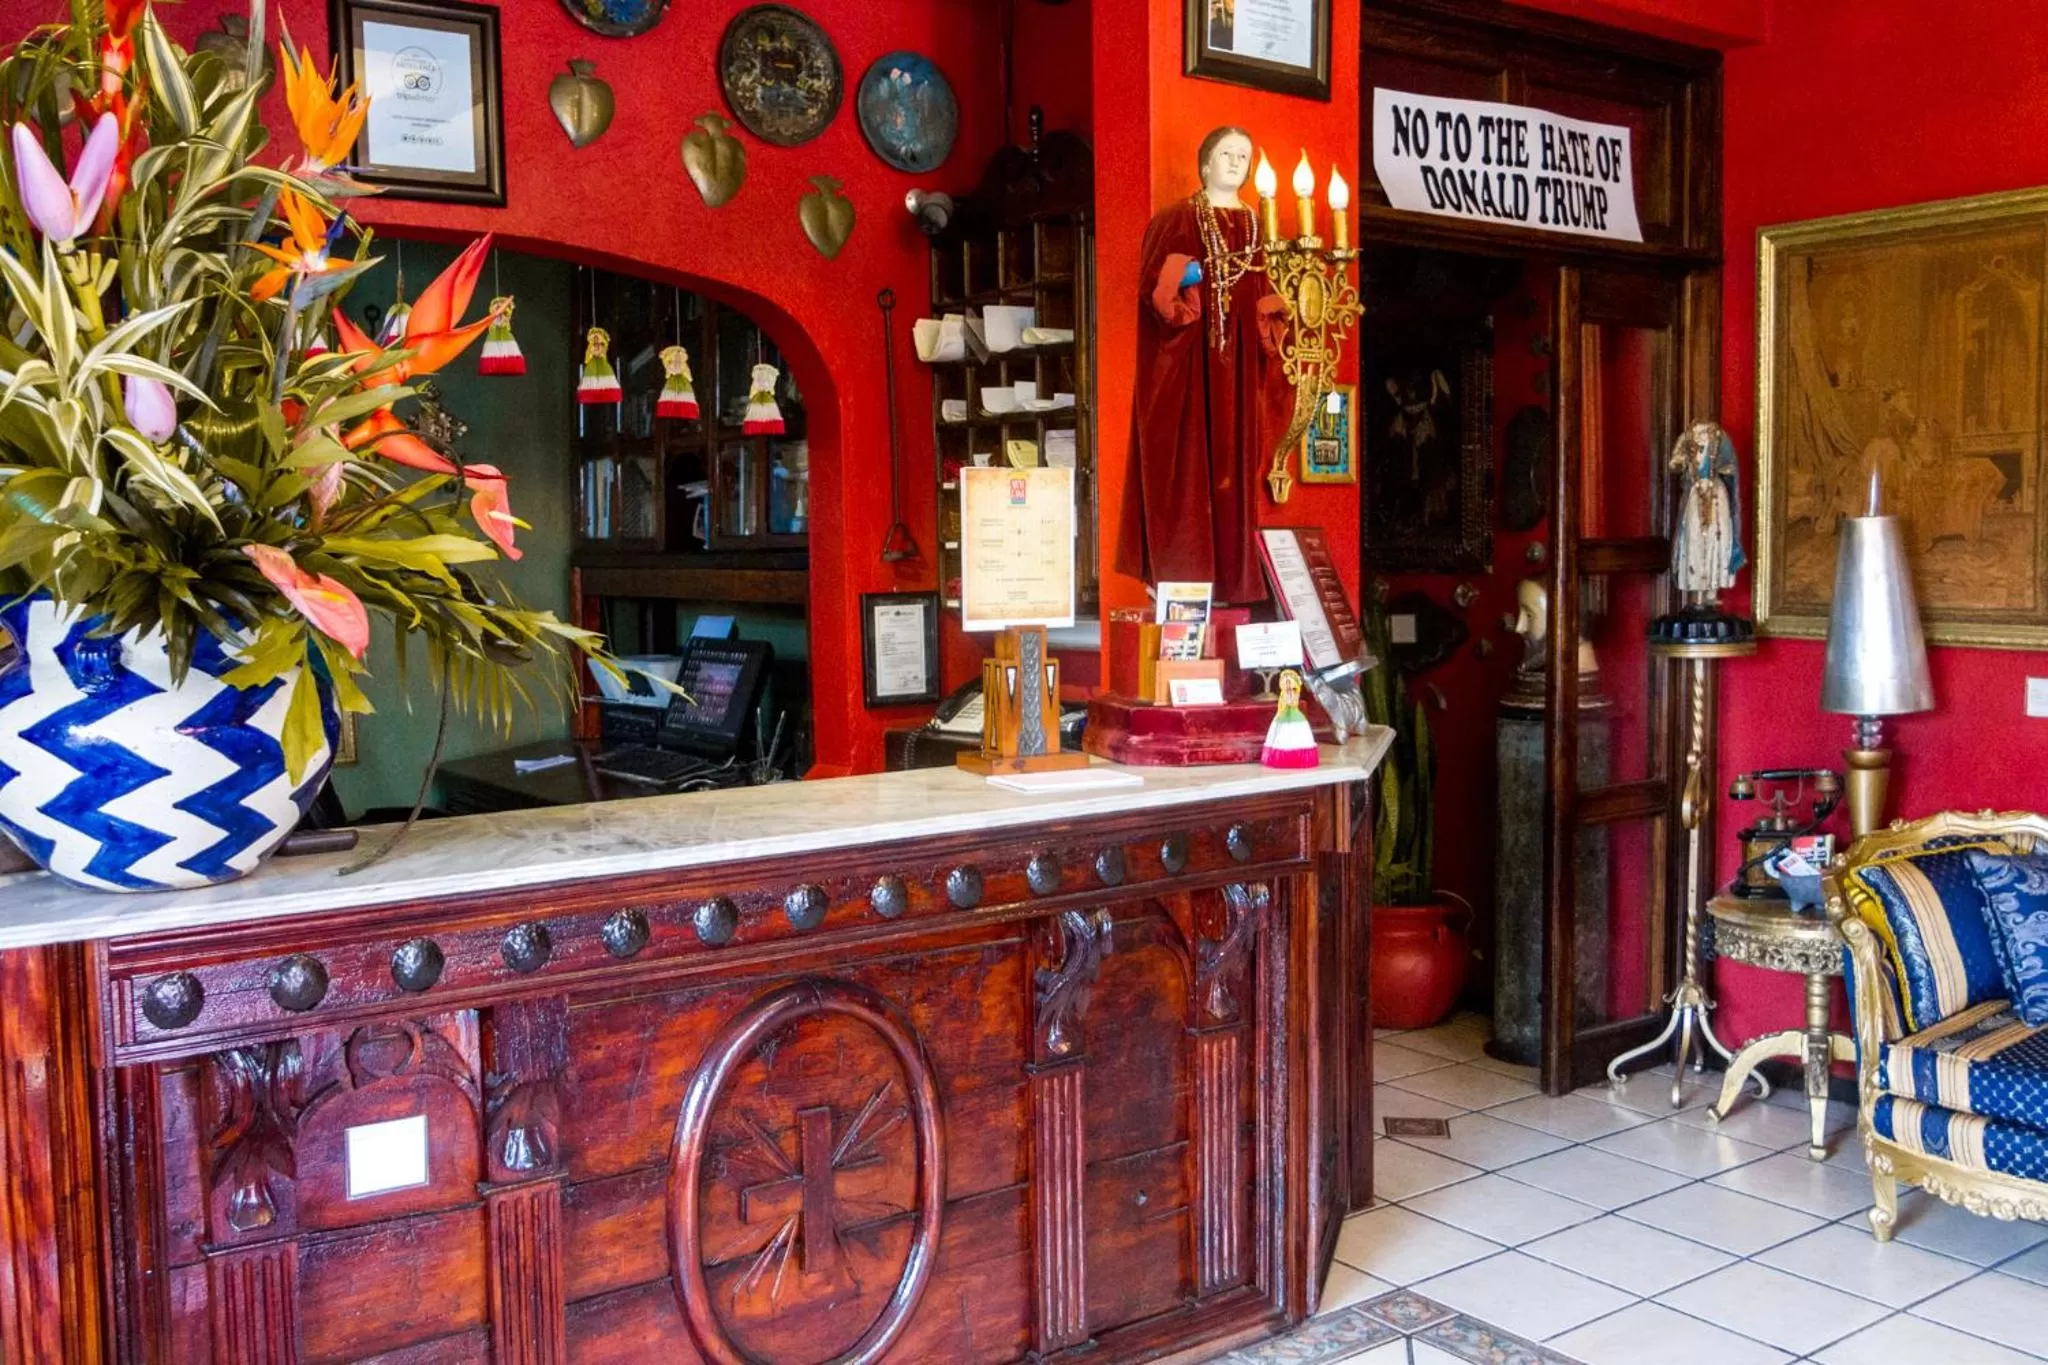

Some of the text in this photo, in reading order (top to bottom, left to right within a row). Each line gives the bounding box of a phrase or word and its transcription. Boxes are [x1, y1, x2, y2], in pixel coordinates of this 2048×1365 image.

[1391, 104, 1622, 184] NO TO THE HATE OF
[1420, 164, 1608, 231] DONALD TRUMP
